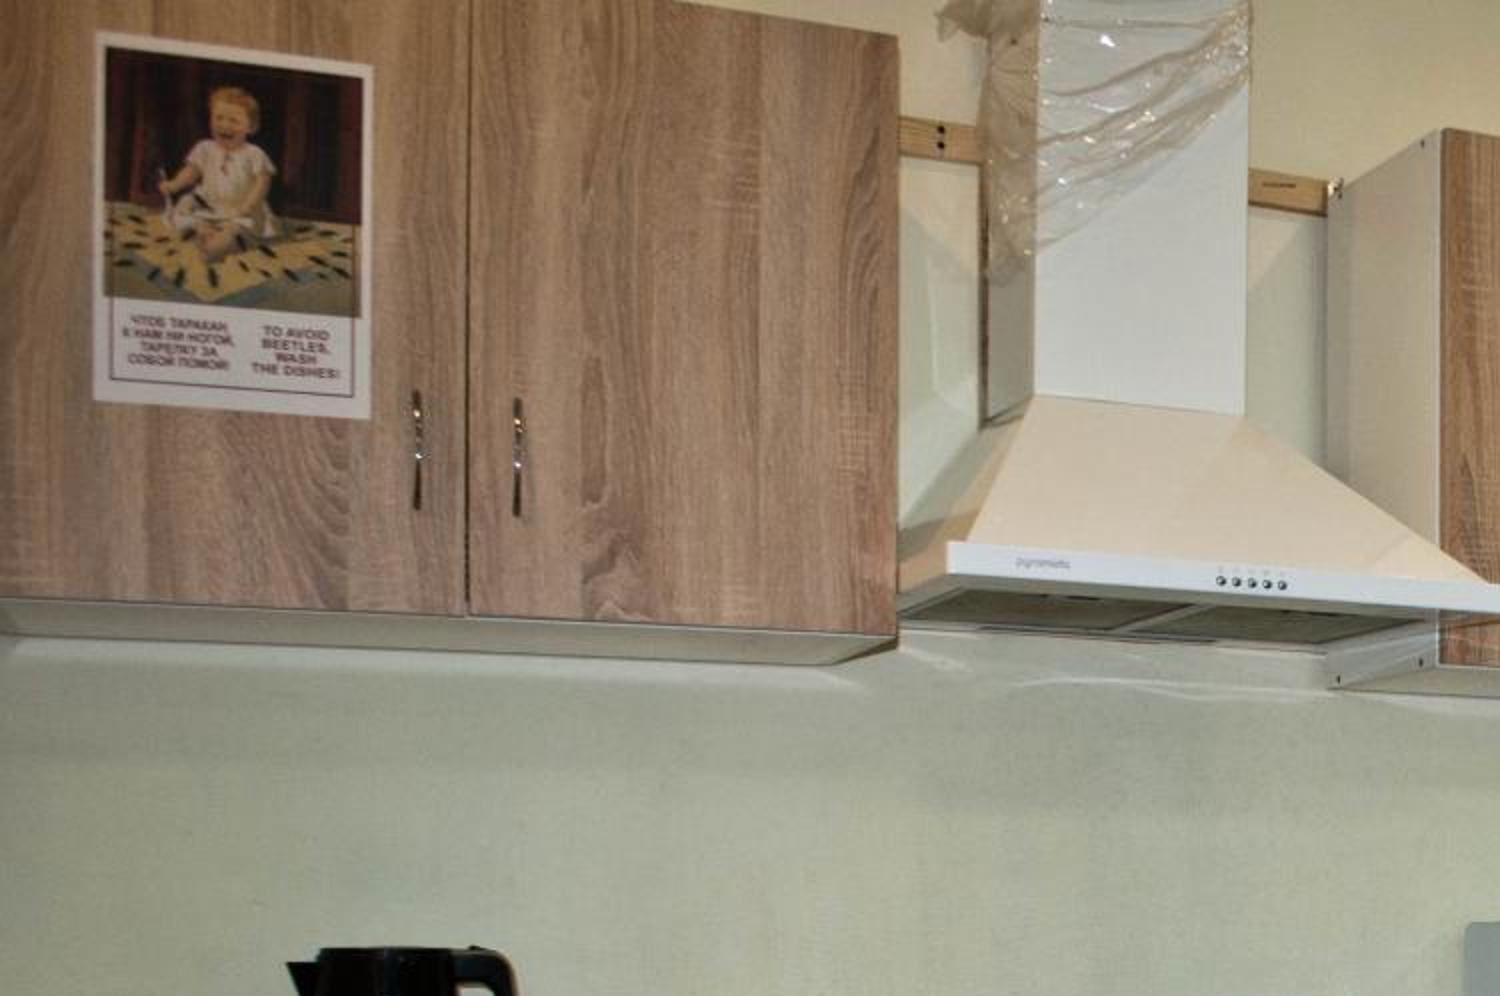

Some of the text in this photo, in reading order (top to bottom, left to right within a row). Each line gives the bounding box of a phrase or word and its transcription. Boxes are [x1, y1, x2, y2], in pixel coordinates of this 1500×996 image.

[263, 325, 330, 341] TO AVOID
[275, 352, 317, 365] WASH
[251, 361, 278, 375] THE
